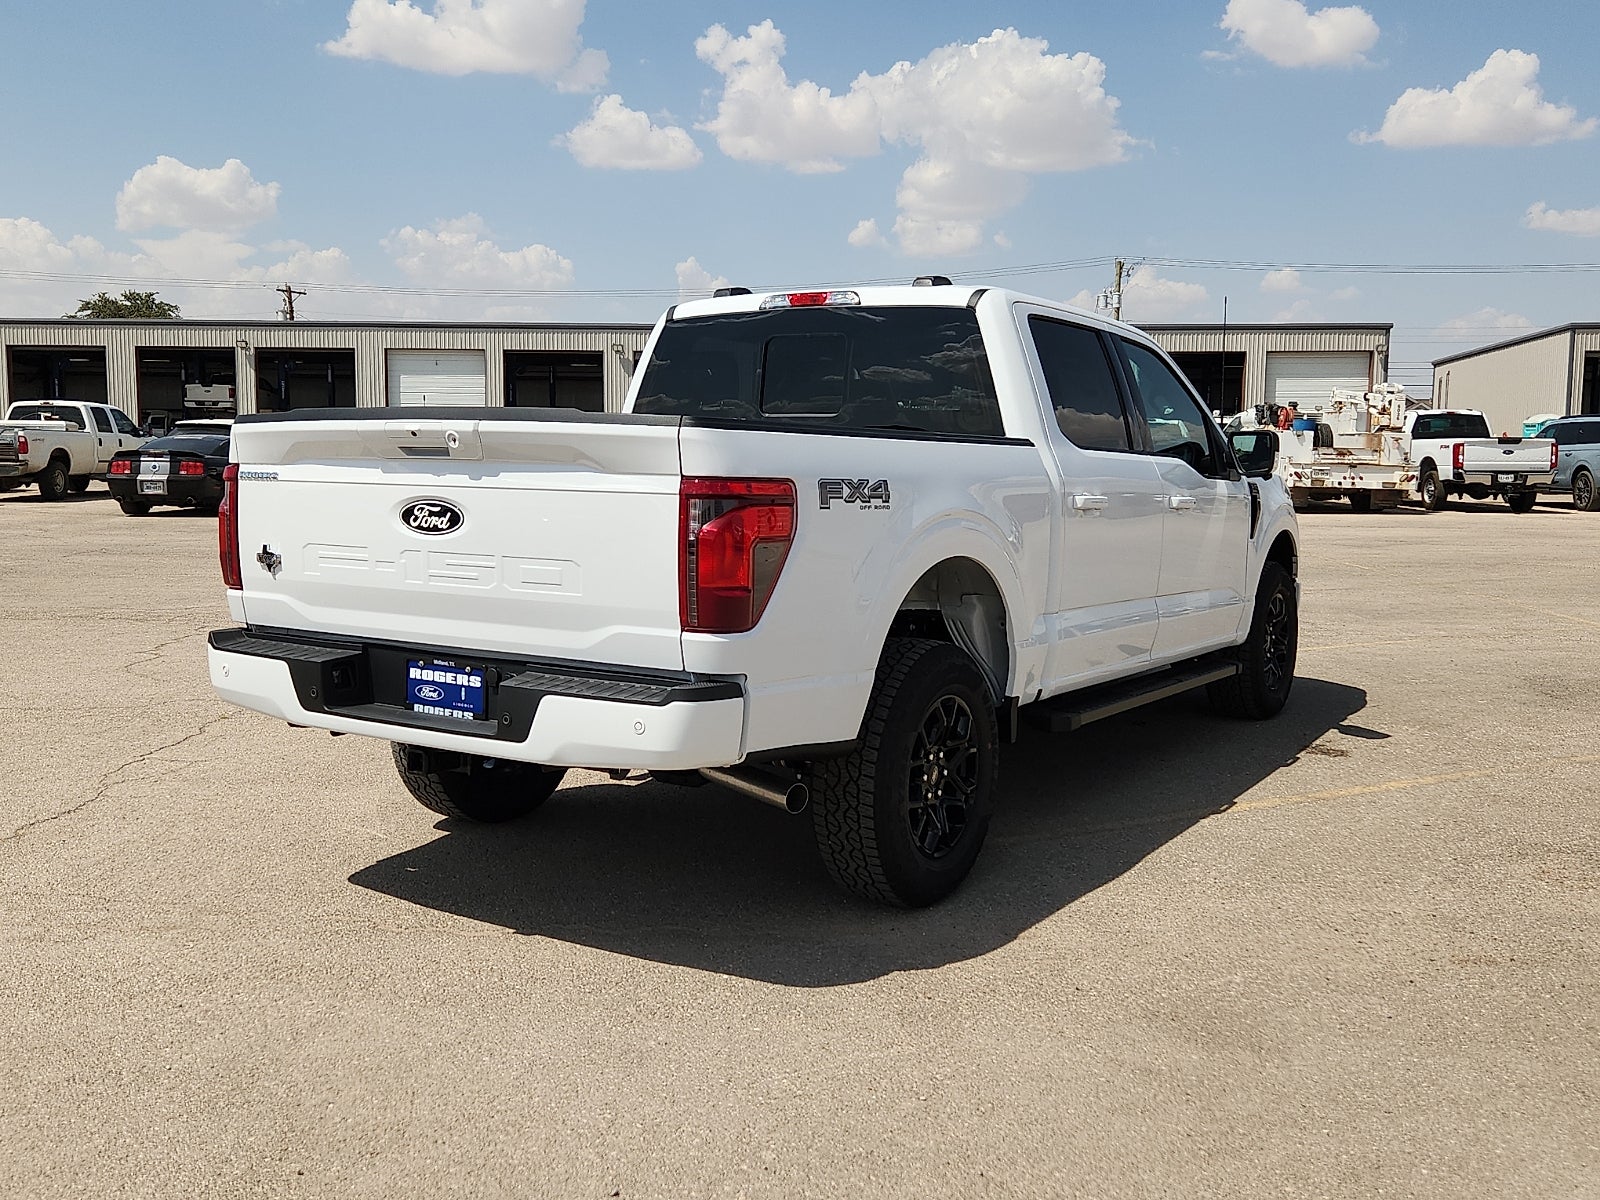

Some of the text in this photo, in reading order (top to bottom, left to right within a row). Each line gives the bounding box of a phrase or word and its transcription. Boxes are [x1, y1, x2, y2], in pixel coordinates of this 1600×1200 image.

[818, 478, 890, 509] FX4
[410, 504, 451, 530] Ford
[302, 543, 582, 596] F-150
[409, 667, 482, 688] ROGERS
[420, 686, 439, 698] Ford
